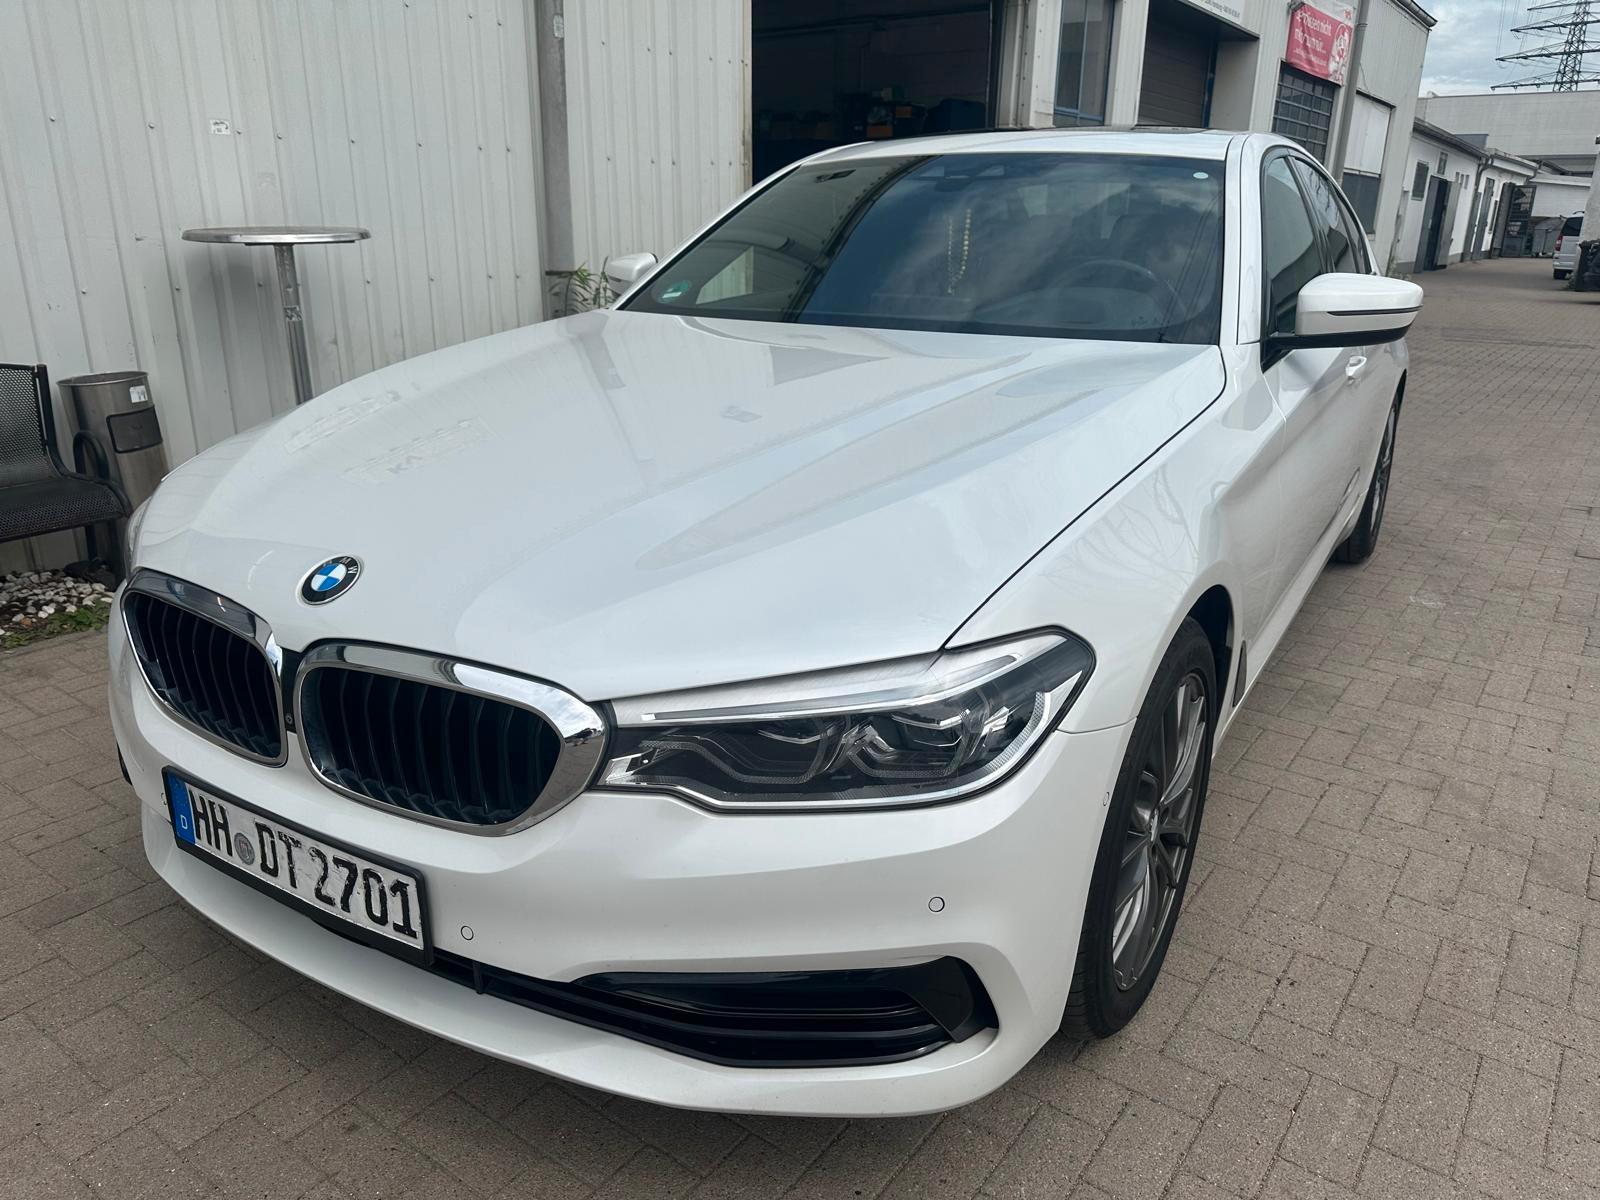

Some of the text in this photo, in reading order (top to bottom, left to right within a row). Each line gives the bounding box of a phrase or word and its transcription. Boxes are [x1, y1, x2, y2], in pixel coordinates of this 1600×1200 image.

[180, 814, 188, 830] D
[188, 789, 418, 939] HH DT 2701
